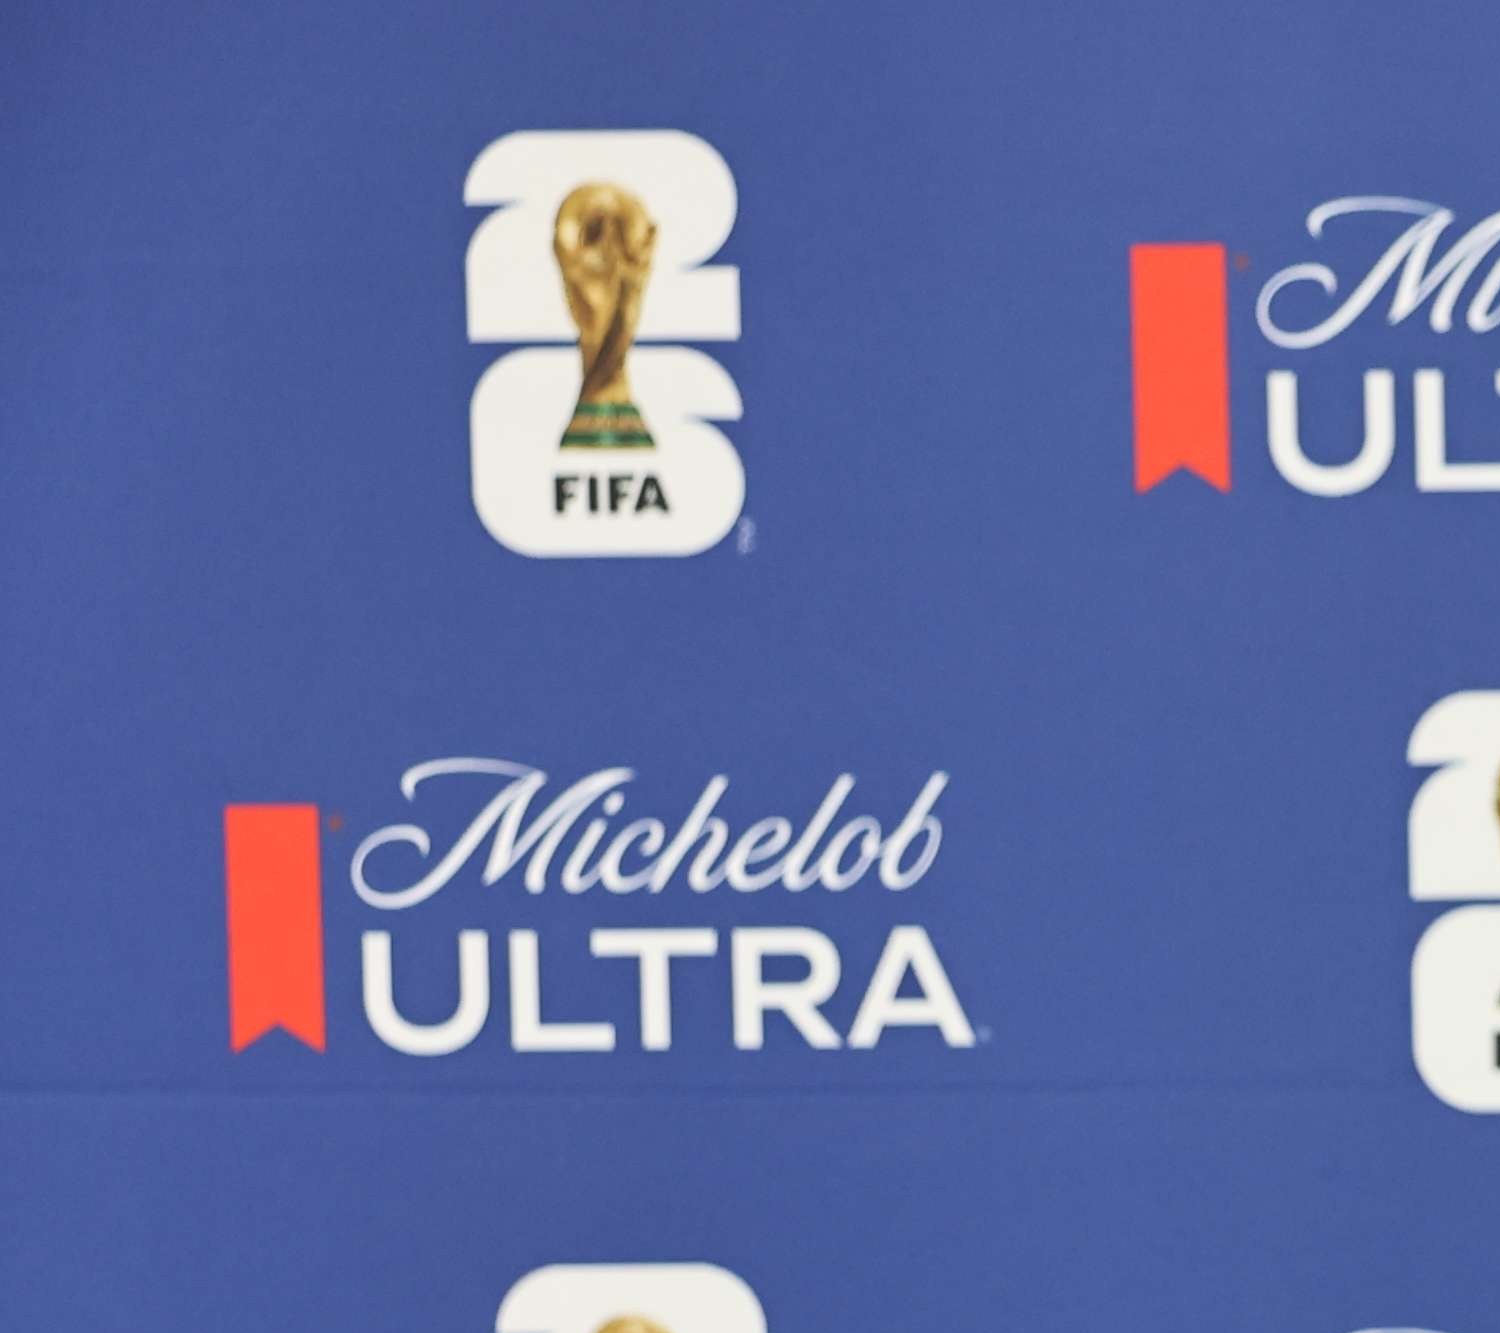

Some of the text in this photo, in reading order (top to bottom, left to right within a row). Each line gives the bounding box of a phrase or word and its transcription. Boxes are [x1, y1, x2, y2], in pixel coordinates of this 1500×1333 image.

[552, 473, 671, 515] FIFA
[350, 757, 949, 910] Michelob
[360, 925, 976, 1057] ULTRA
